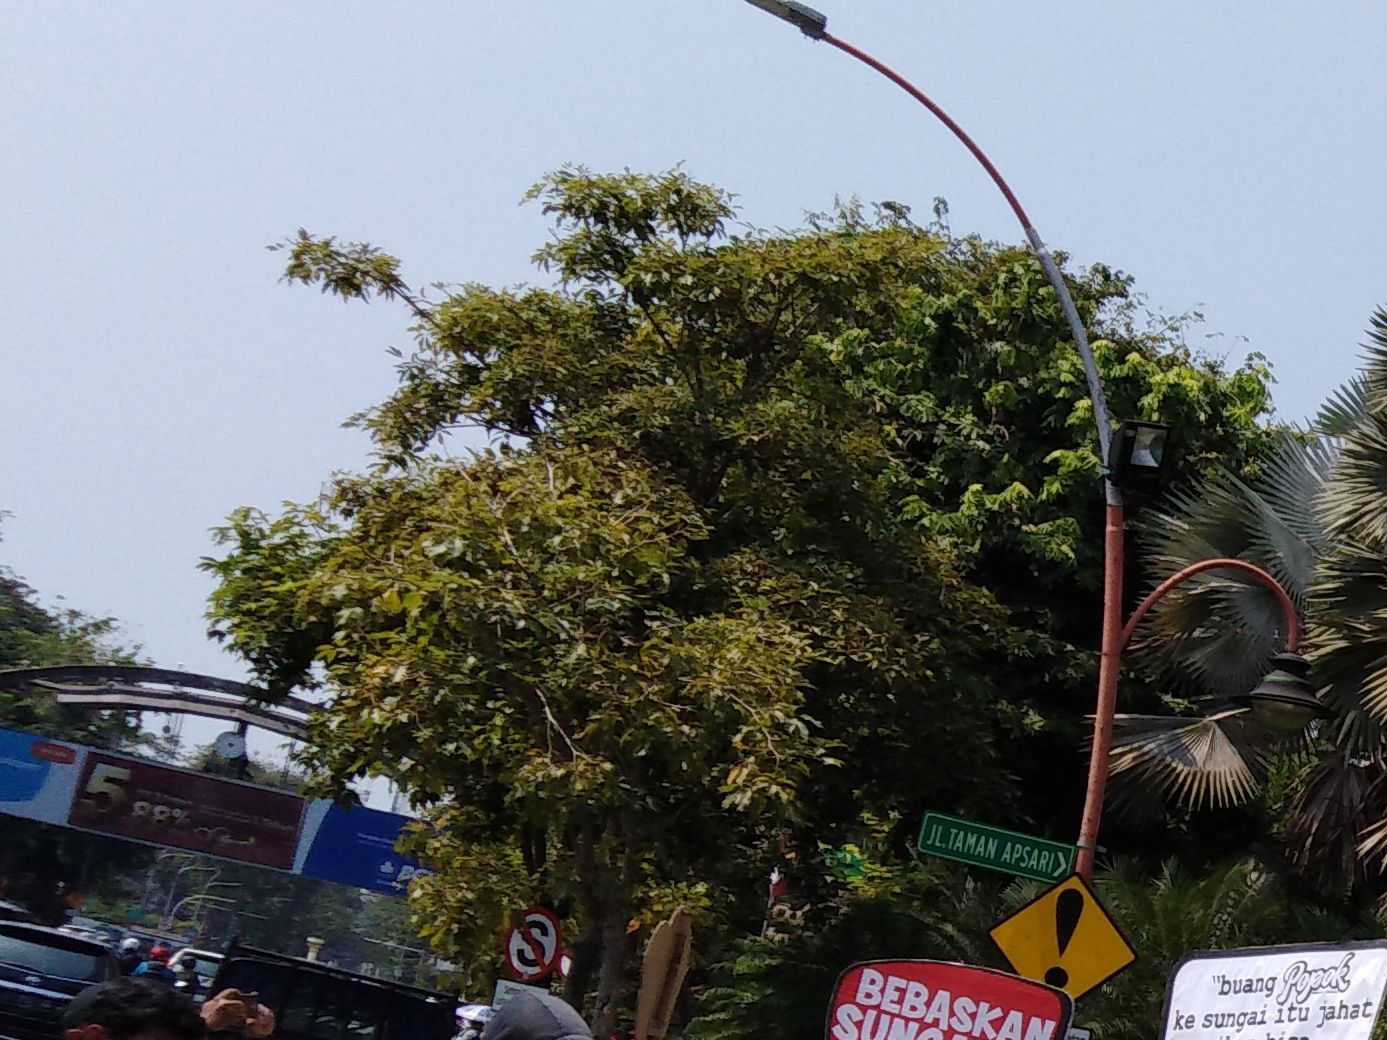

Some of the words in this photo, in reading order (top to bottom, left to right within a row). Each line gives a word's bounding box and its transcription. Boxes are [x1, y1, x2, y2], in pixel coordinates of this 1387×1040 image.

[1001, 842, 1055, 874] APSARI
[1173, 1010, 1196, 1031] ke
[1201, 1004, 1268, 1033] sungai
[1274, 1002, 1310, 1024] itu
[1316, 1000, 1373, 1028] jahat
